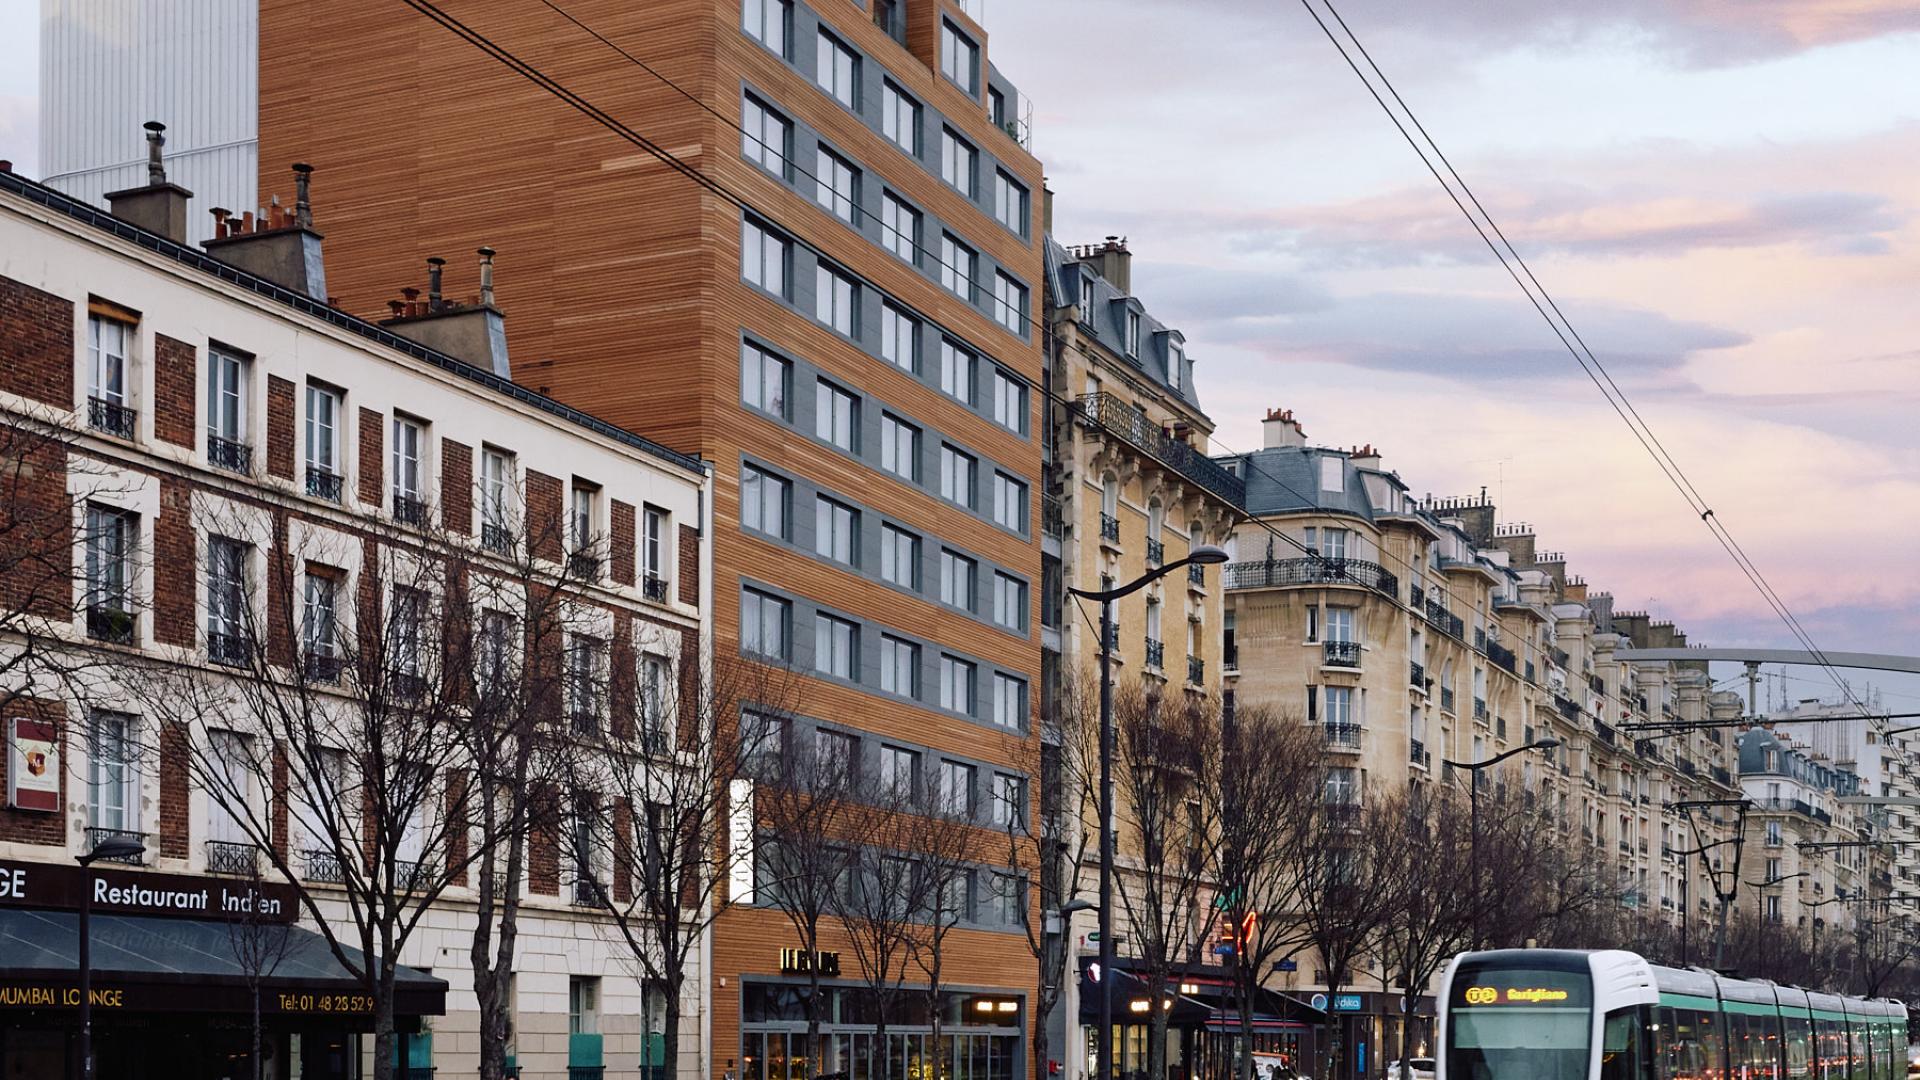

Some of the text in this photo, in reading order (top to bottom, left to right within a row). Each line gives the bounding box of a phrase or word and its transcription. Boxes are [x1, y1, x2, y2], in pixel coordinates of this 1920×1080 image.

[94, 878, 280, 915] Restaurant Inden
[300, 995, 314, 1011] 01
[318, 995, 331, 1011] 48
[334, 996, 349, 1011] 28
[350, 996, 365, 1012] 52
[367, 996, 375, 1011] 9
